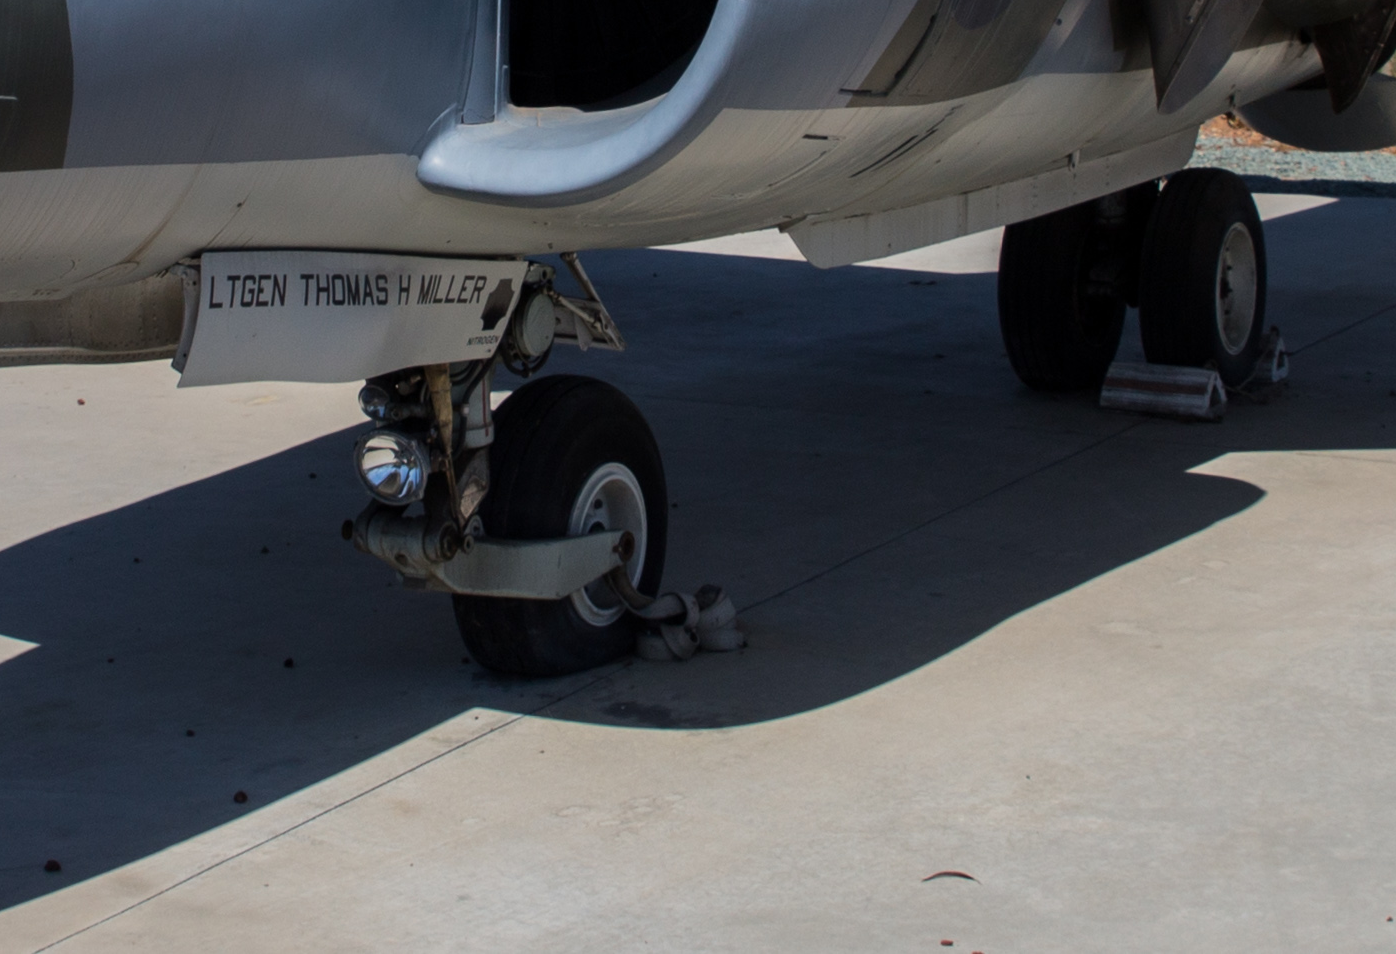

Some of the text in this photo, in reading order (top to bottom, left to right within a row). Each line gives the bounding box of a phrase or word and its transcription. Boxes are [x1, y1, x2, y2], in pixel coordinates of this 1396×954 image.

[208, 273, 488, 309] LTGEN THOMAS H MILLER
[466, 335, 501, 347] NITROGEN
